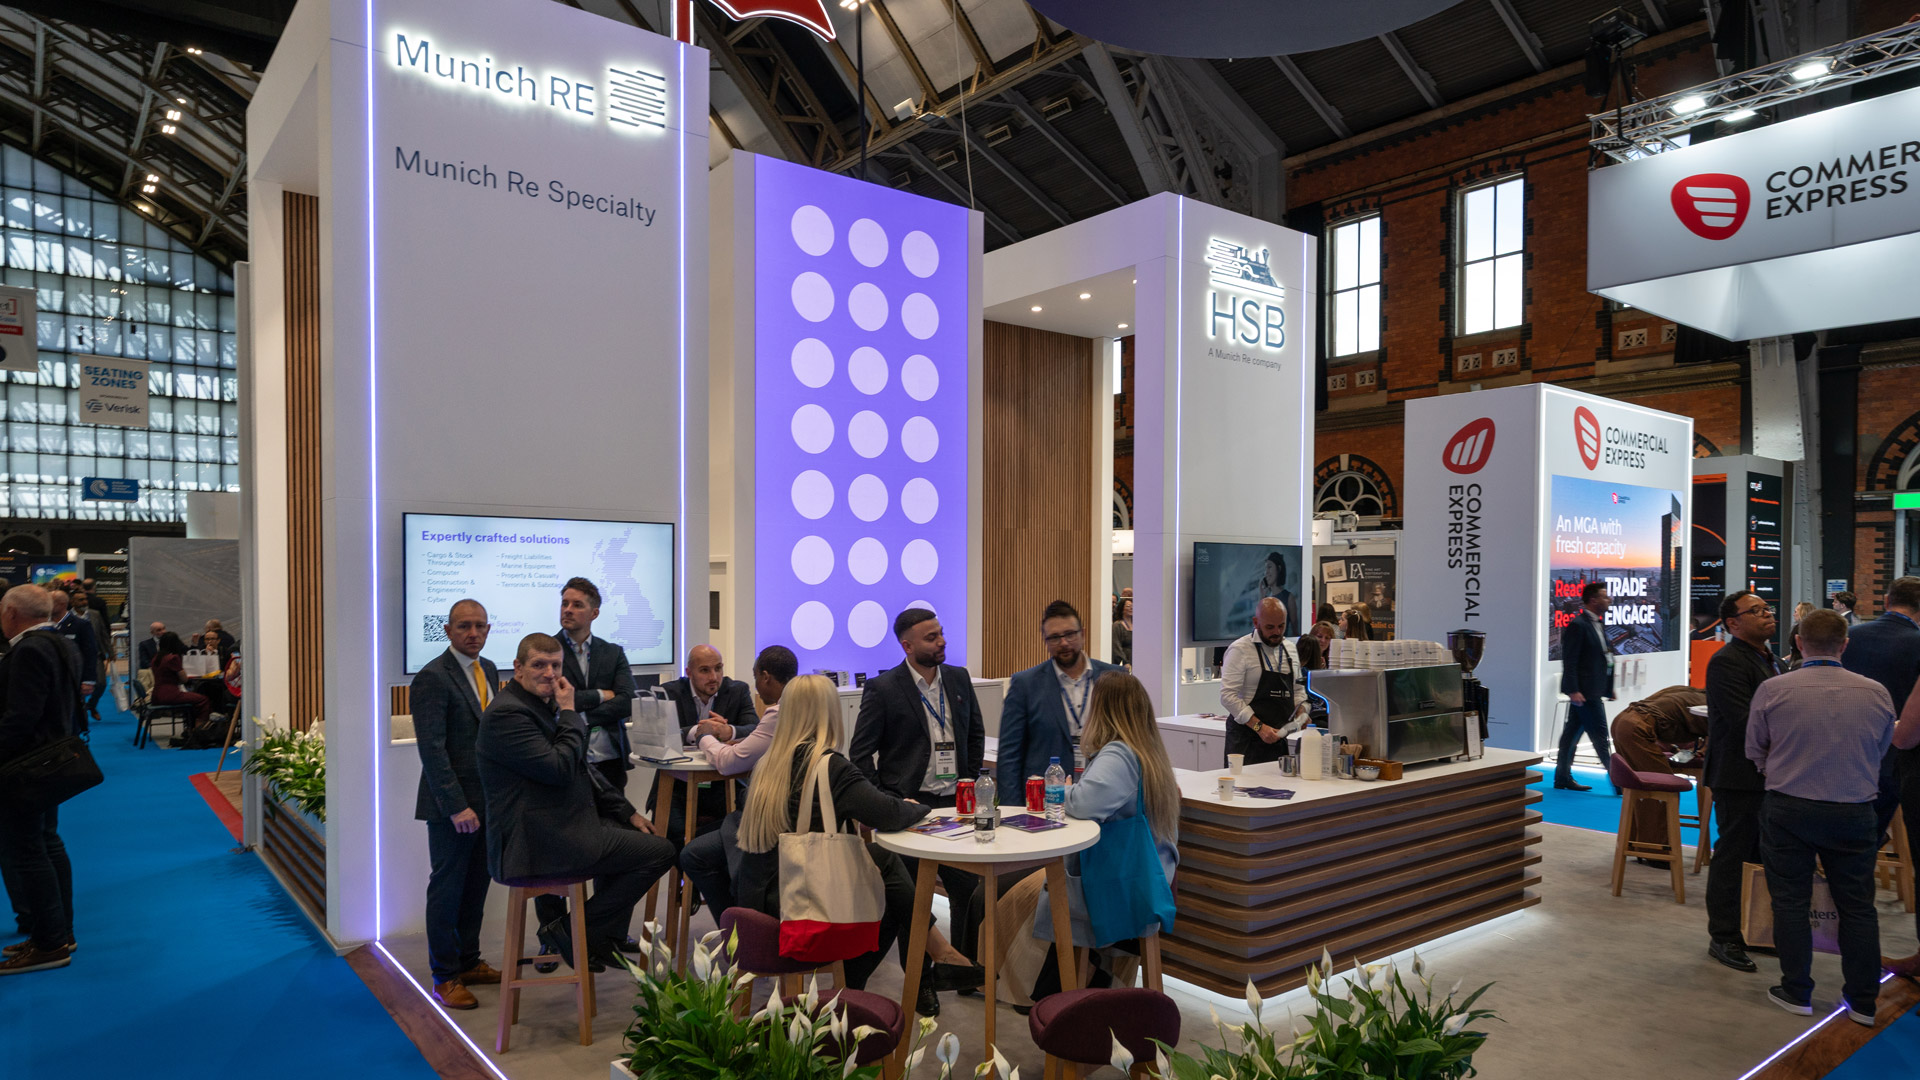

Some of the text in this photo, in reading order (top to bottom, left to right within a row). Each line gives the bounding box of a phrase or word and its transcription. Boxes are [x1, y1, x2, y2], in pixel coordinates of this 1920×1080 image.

[396, 34, 594, 116] Munich RE
[395, 146, 656, 227] Munich Re Specialty
[1767, 170, 1908, 219] EXPRESS
[1212, 292, 1285, 348] HSB
[1208, 347, 1282, 372] A Munich Re company
[84, 366, 143, 380] SEATING
[91, 376, 137, 389] ZONES
[104, 403, 141, 414] Verisk
[1605, 426, 1669, 454] COMMERCIAL
[1605, 447, 1645, 469] EXPRESS
[1448, 485, 1464, 569] EXPRESS
[1556, 514, 1622, 536] An MGA with
[422, 530, 570, 545] Expertly crafted solutions
[1556, 534, 1626, 560] fresh capacity
[1465, 483, 1482, 622] COMMERCIAL
[501, 572, 527, 580] Property
[534, 572, 559, 580] Casualty
[1555, 577, 1647, 597] Read TRADE
[1605, 605, 1655, 625] ENGAGE
